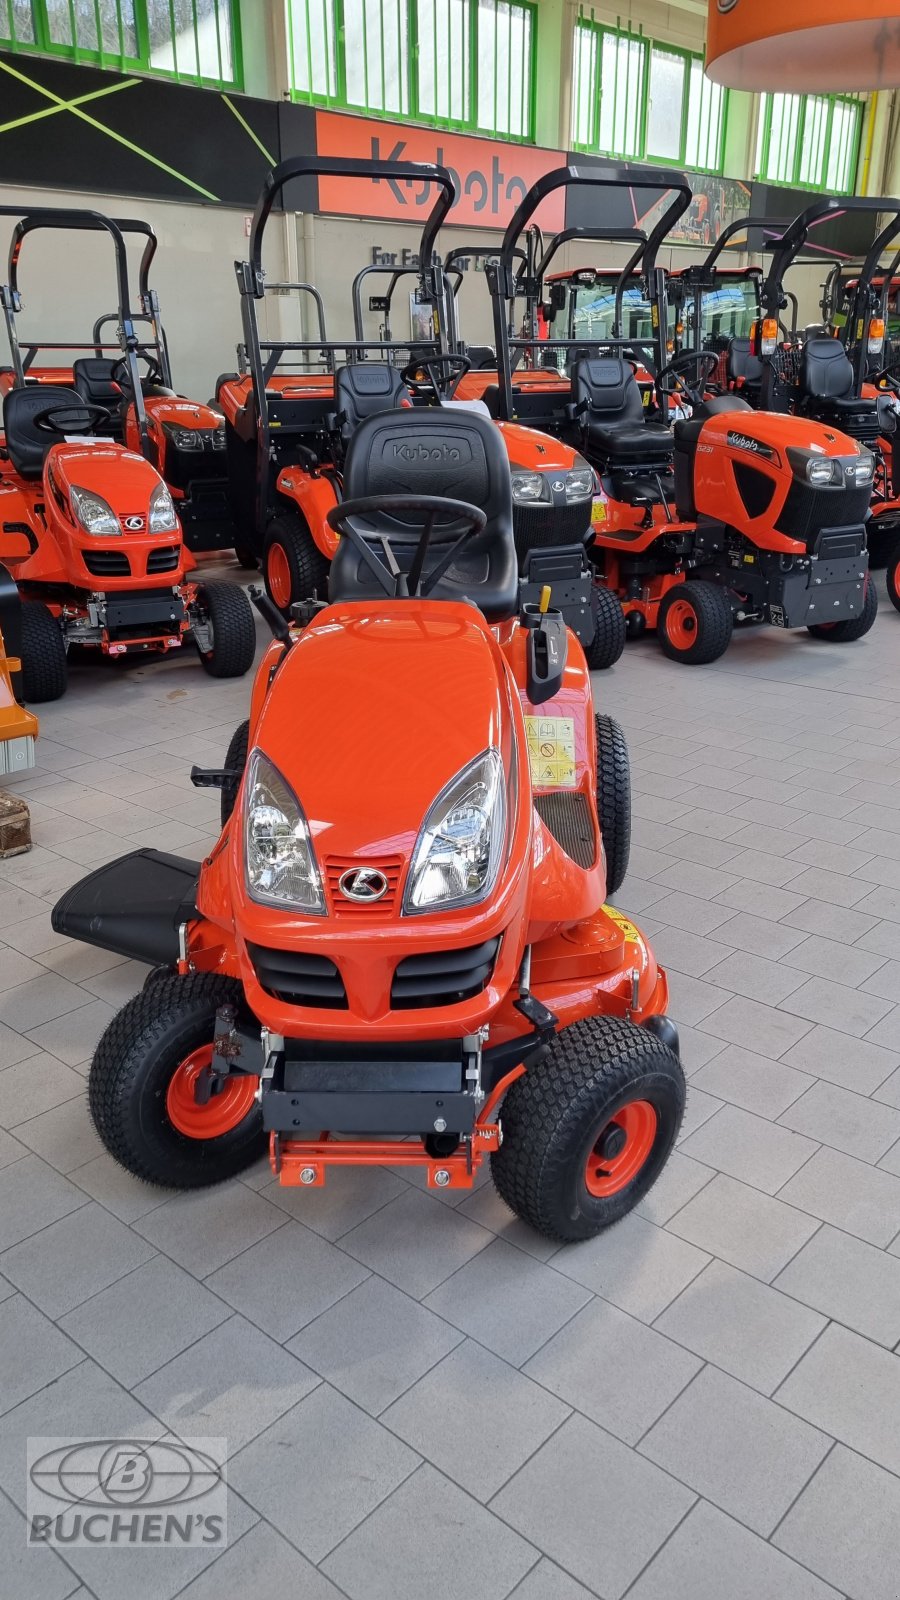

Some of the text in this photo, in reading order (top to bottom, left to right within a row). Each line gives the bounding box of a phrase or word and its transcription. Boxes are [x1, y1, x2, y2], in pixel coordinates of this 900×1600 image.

[372, 246, 397, 266] For
[730, 432, 758, 451] Kubota
[393, 443, 460, 461] Kubota
